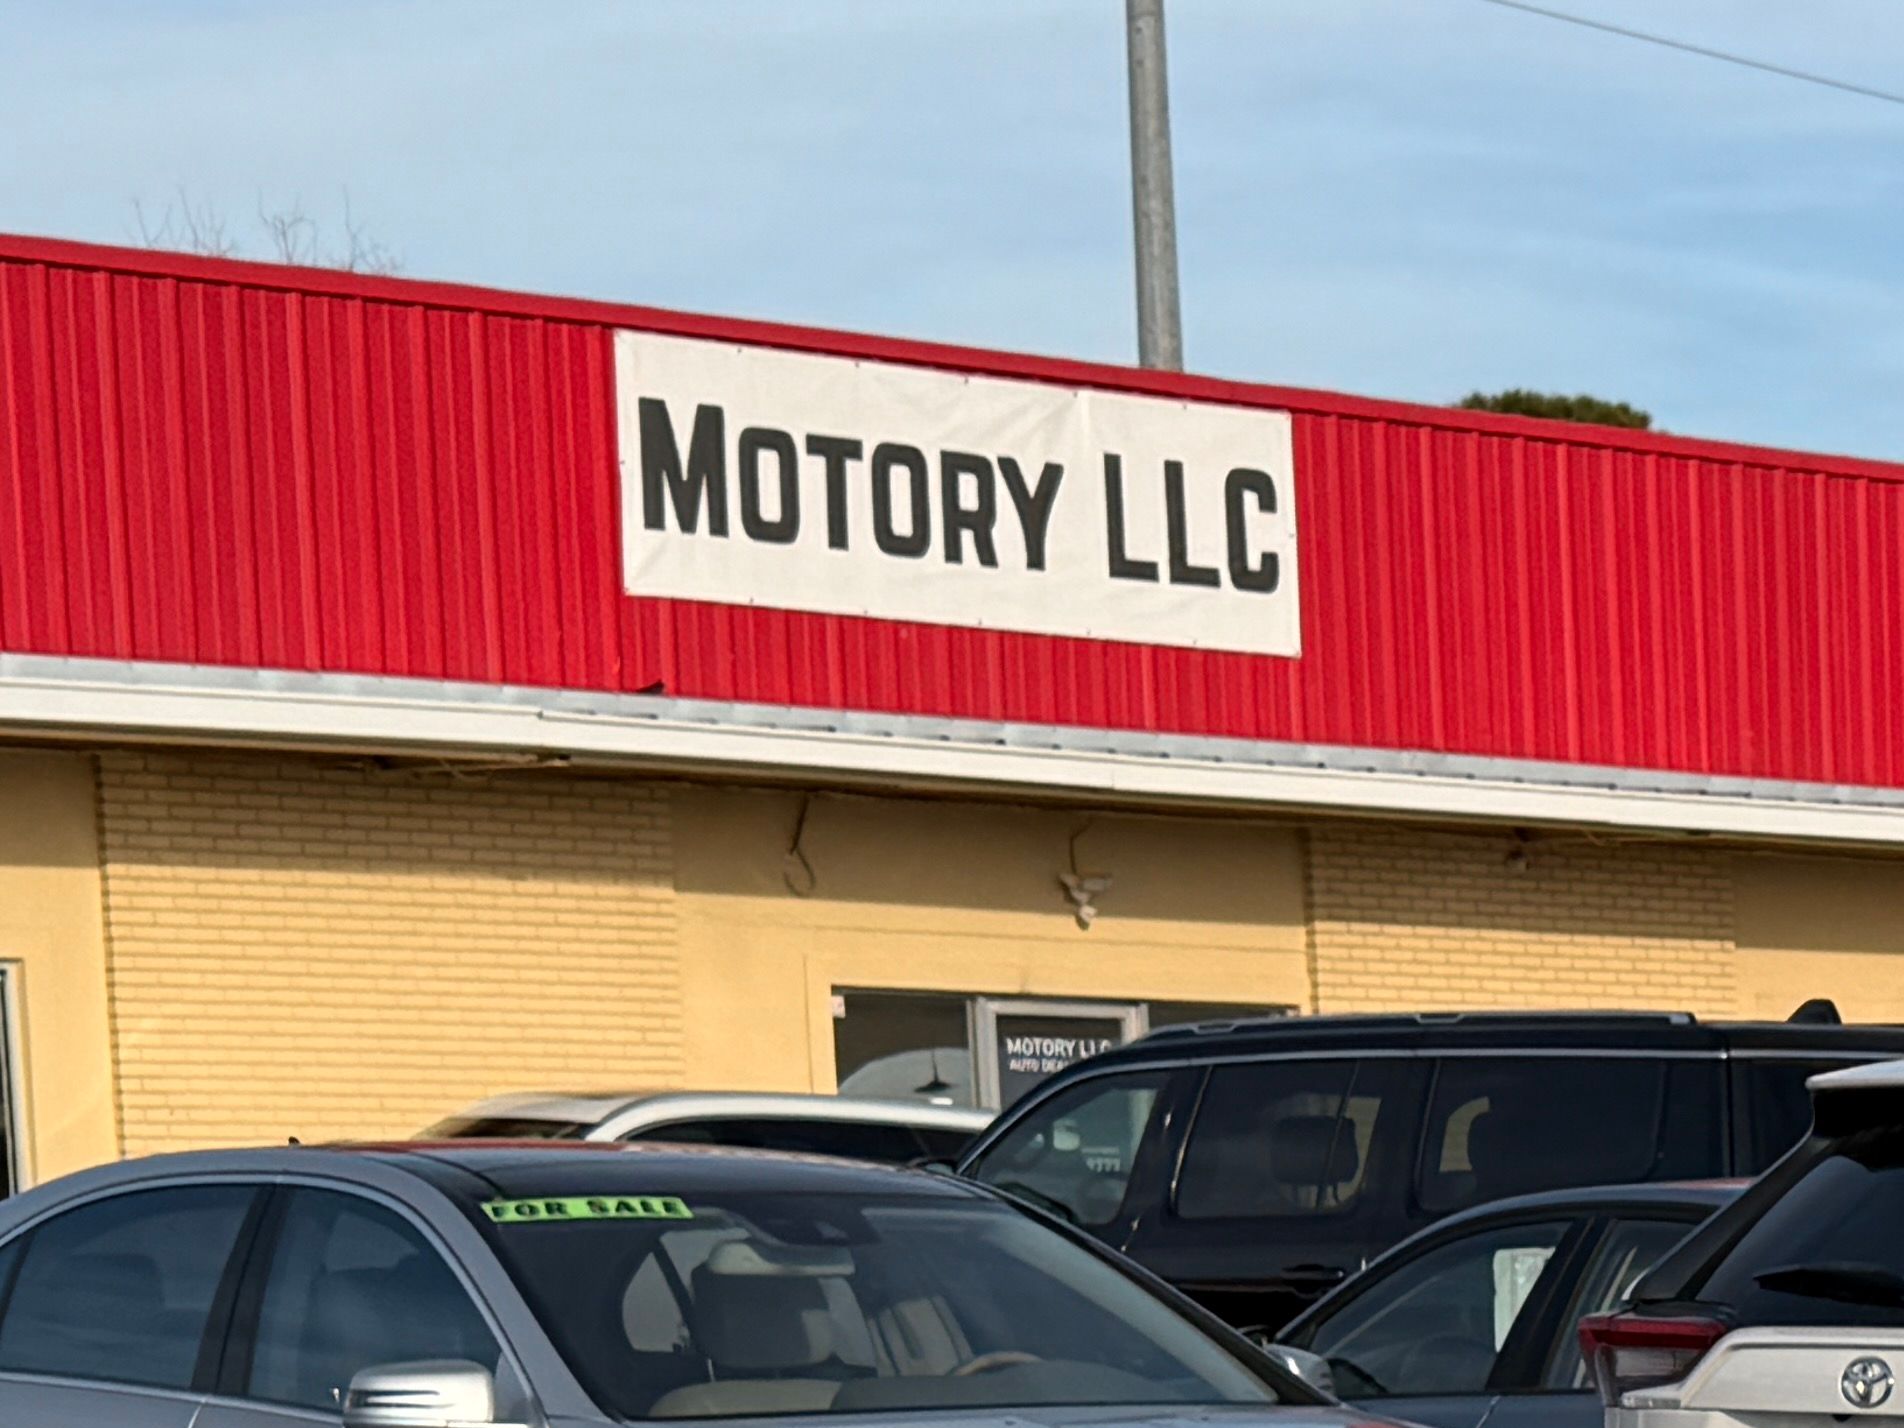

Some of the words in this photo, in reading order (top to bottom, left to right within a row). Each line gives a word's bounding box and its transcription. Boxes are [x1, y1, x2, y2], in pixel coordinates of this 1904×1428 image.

[637, 396, 1065, 572] MOTORY
[1103, 454, 1280, 594] LLC
[1006, 1036, 1077, 1057] MOTORY
[491, 1201, 568, 1217] FOR
[586, 1199, 681, 1215] SALE
